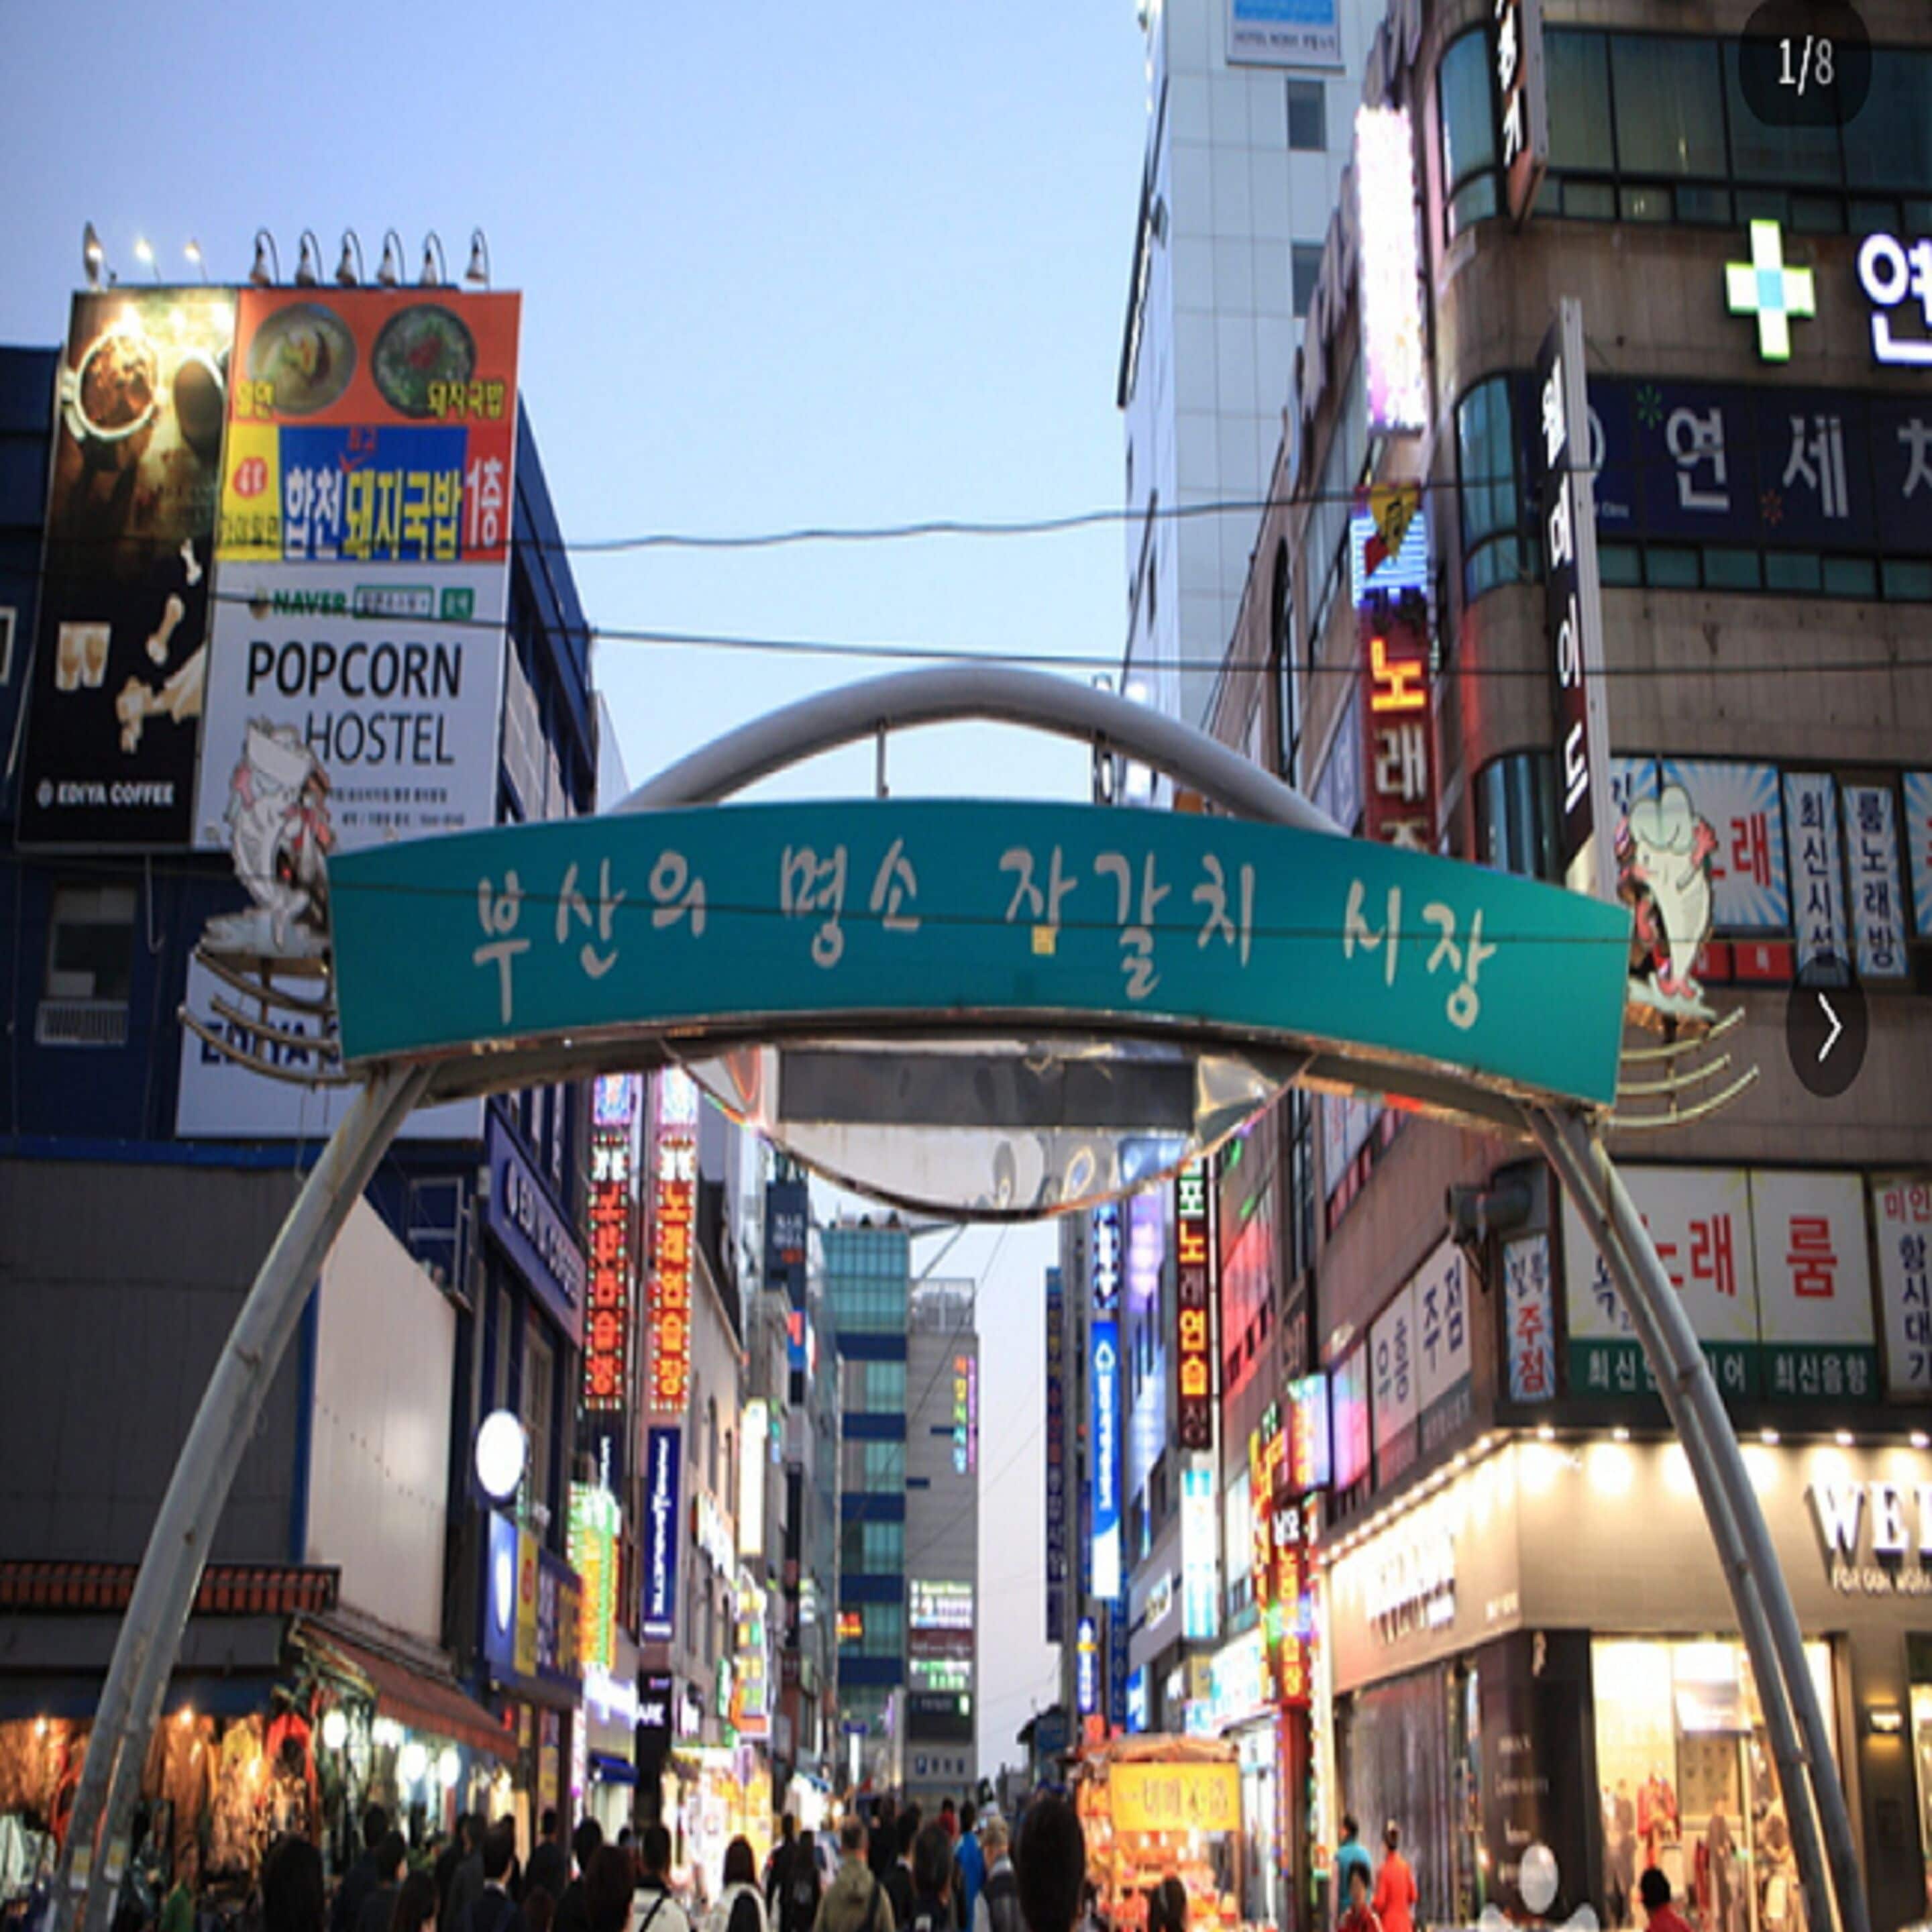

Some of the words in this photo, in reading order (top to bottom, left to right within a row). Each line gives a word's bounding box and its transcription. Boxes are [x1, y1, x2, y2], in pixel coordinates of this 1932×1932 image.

[286, 466, 462, 559] 합천돼지국밥
[468, 458, 502, 549] 1층
[274, 590, 346, 616] NAVER
[246, 641, 463, 699] POPCORN
[305, 712, 455, 765] HOSTEL
[58, 783, 106, 804] EDIYA
[111, 782, 174, 806] COFFEE
[472, 850, 708, 1024] 부산의
[778, 838, 920, 968] 명소
[998, 845, 1255, 1000] 자갈치
[1344, 879, 1497, 1030] 시장
[1786, 1216, 1837, 1299] 룸
